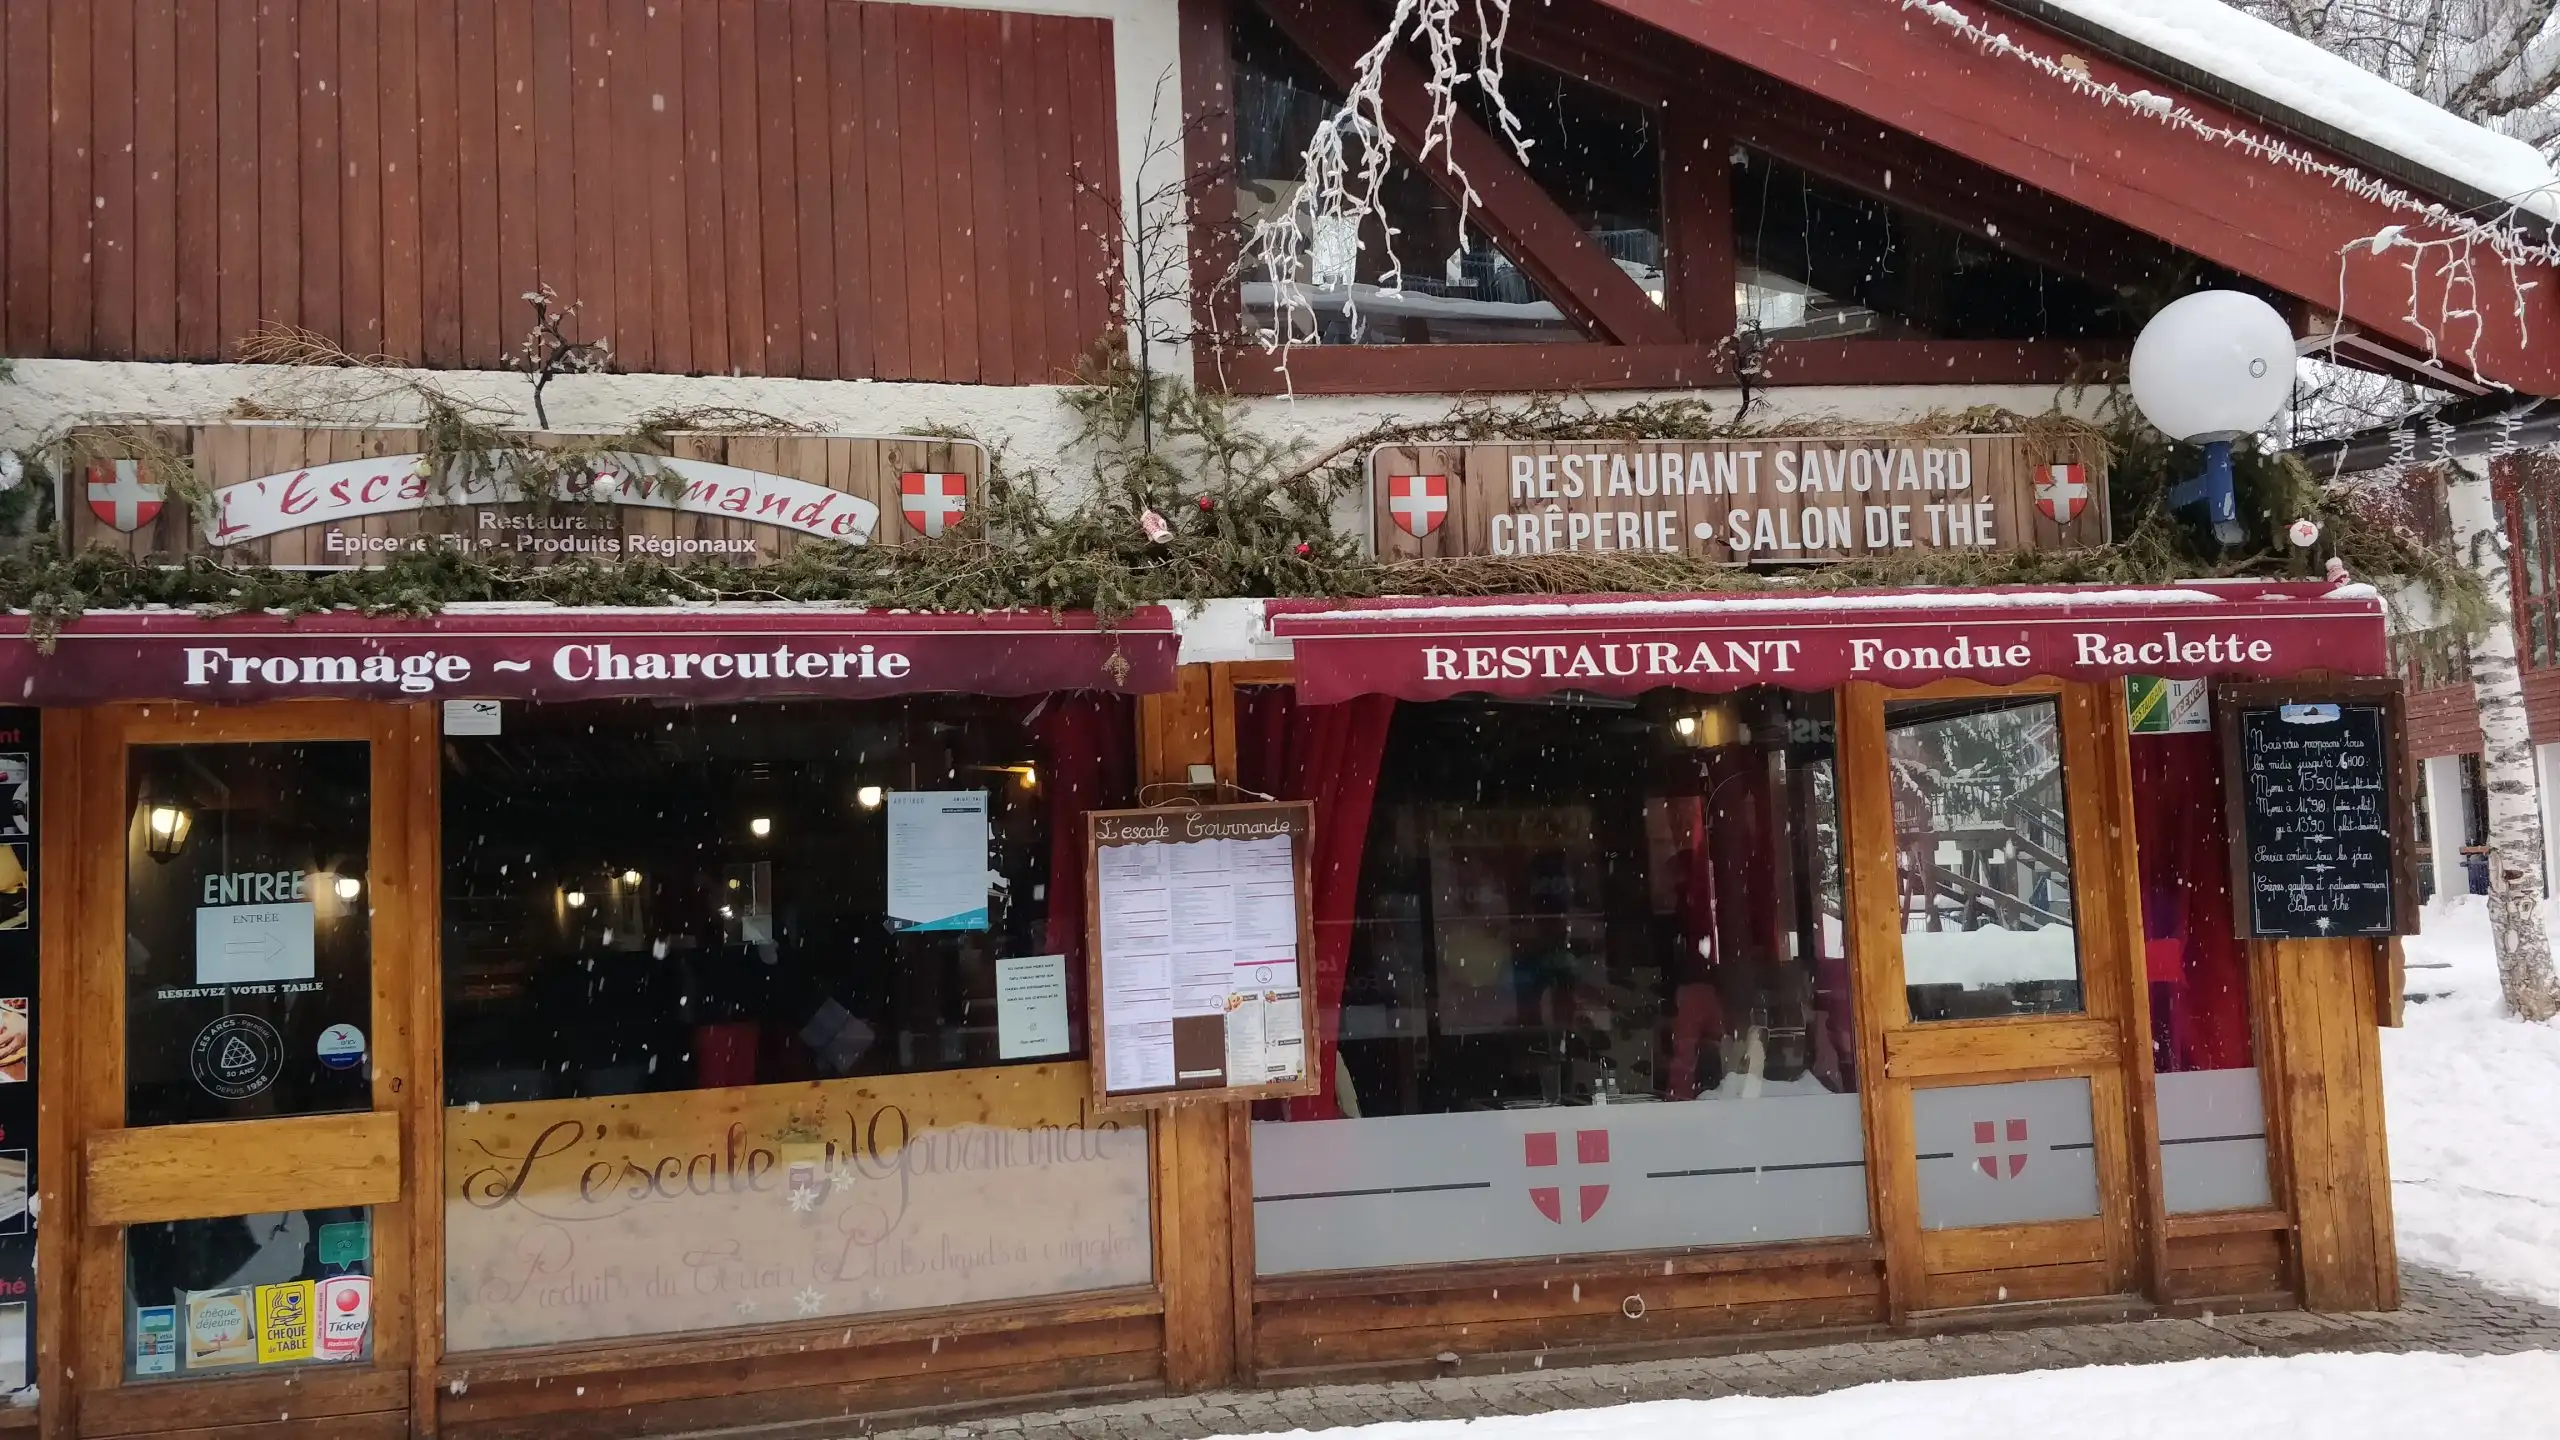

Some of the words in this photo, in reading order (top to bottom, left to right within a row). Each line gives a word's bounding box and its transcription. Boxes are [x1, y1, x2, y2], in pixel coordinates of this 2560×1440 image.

[1511, 451, 1760, 499] RESTAURANT
[1775, 448, 1972, 494] SAVOYARD
[479, 511, 617, 530] Restaurat
[1491, 504, 1680, 557] CRÊPERIE
[1728, 508, 1853, 551] SALON
[1865, 506, 1910, 549] DE
[1923, 494, 1997, 547] THÉ
[517, 534, 621, 553] Produits
[629, 533, 757, 558] Régionaux
[1422, 638, 1801, 681] RESTAURANT
[1849, 637, 2032, 672] Fondue
[2073, 631, 2273, 666] Raclette
[183, 647, 472, 693] Fromage
[552, 643, 912, 682] Charcuterie
[1096, 815, 1170, 841] L'escale
[203, 869, 306, 904] ENTREE
[2318, 895, 2329, 911] de
[232, 911, 280, 924] ENTRÉE
[157, 986, 226, 1000] RESERVEZ
[231, 984, 276, 996] VOTRE
[281, 981, 324, 993] TABLE
[197, 1034, 211, 1052] LES
[210, 1019, 236, 1036] ARCS
[239, 1066, 256, 1076] ANS
[215, 1084, 245, 1095] DEPUIS
[246, 1075, 268, 1092] 1968
[463, 1119, 777, 1220] L'escale
[646, 1264, 681, 1299] du
[195, 1317, 242, 1330] déjeuner
[199, 1308, 237, 1320] chèque
[267, 1325, 307, 1341] CHEQUE
[276, 1338, 308, 1352] TABLE
